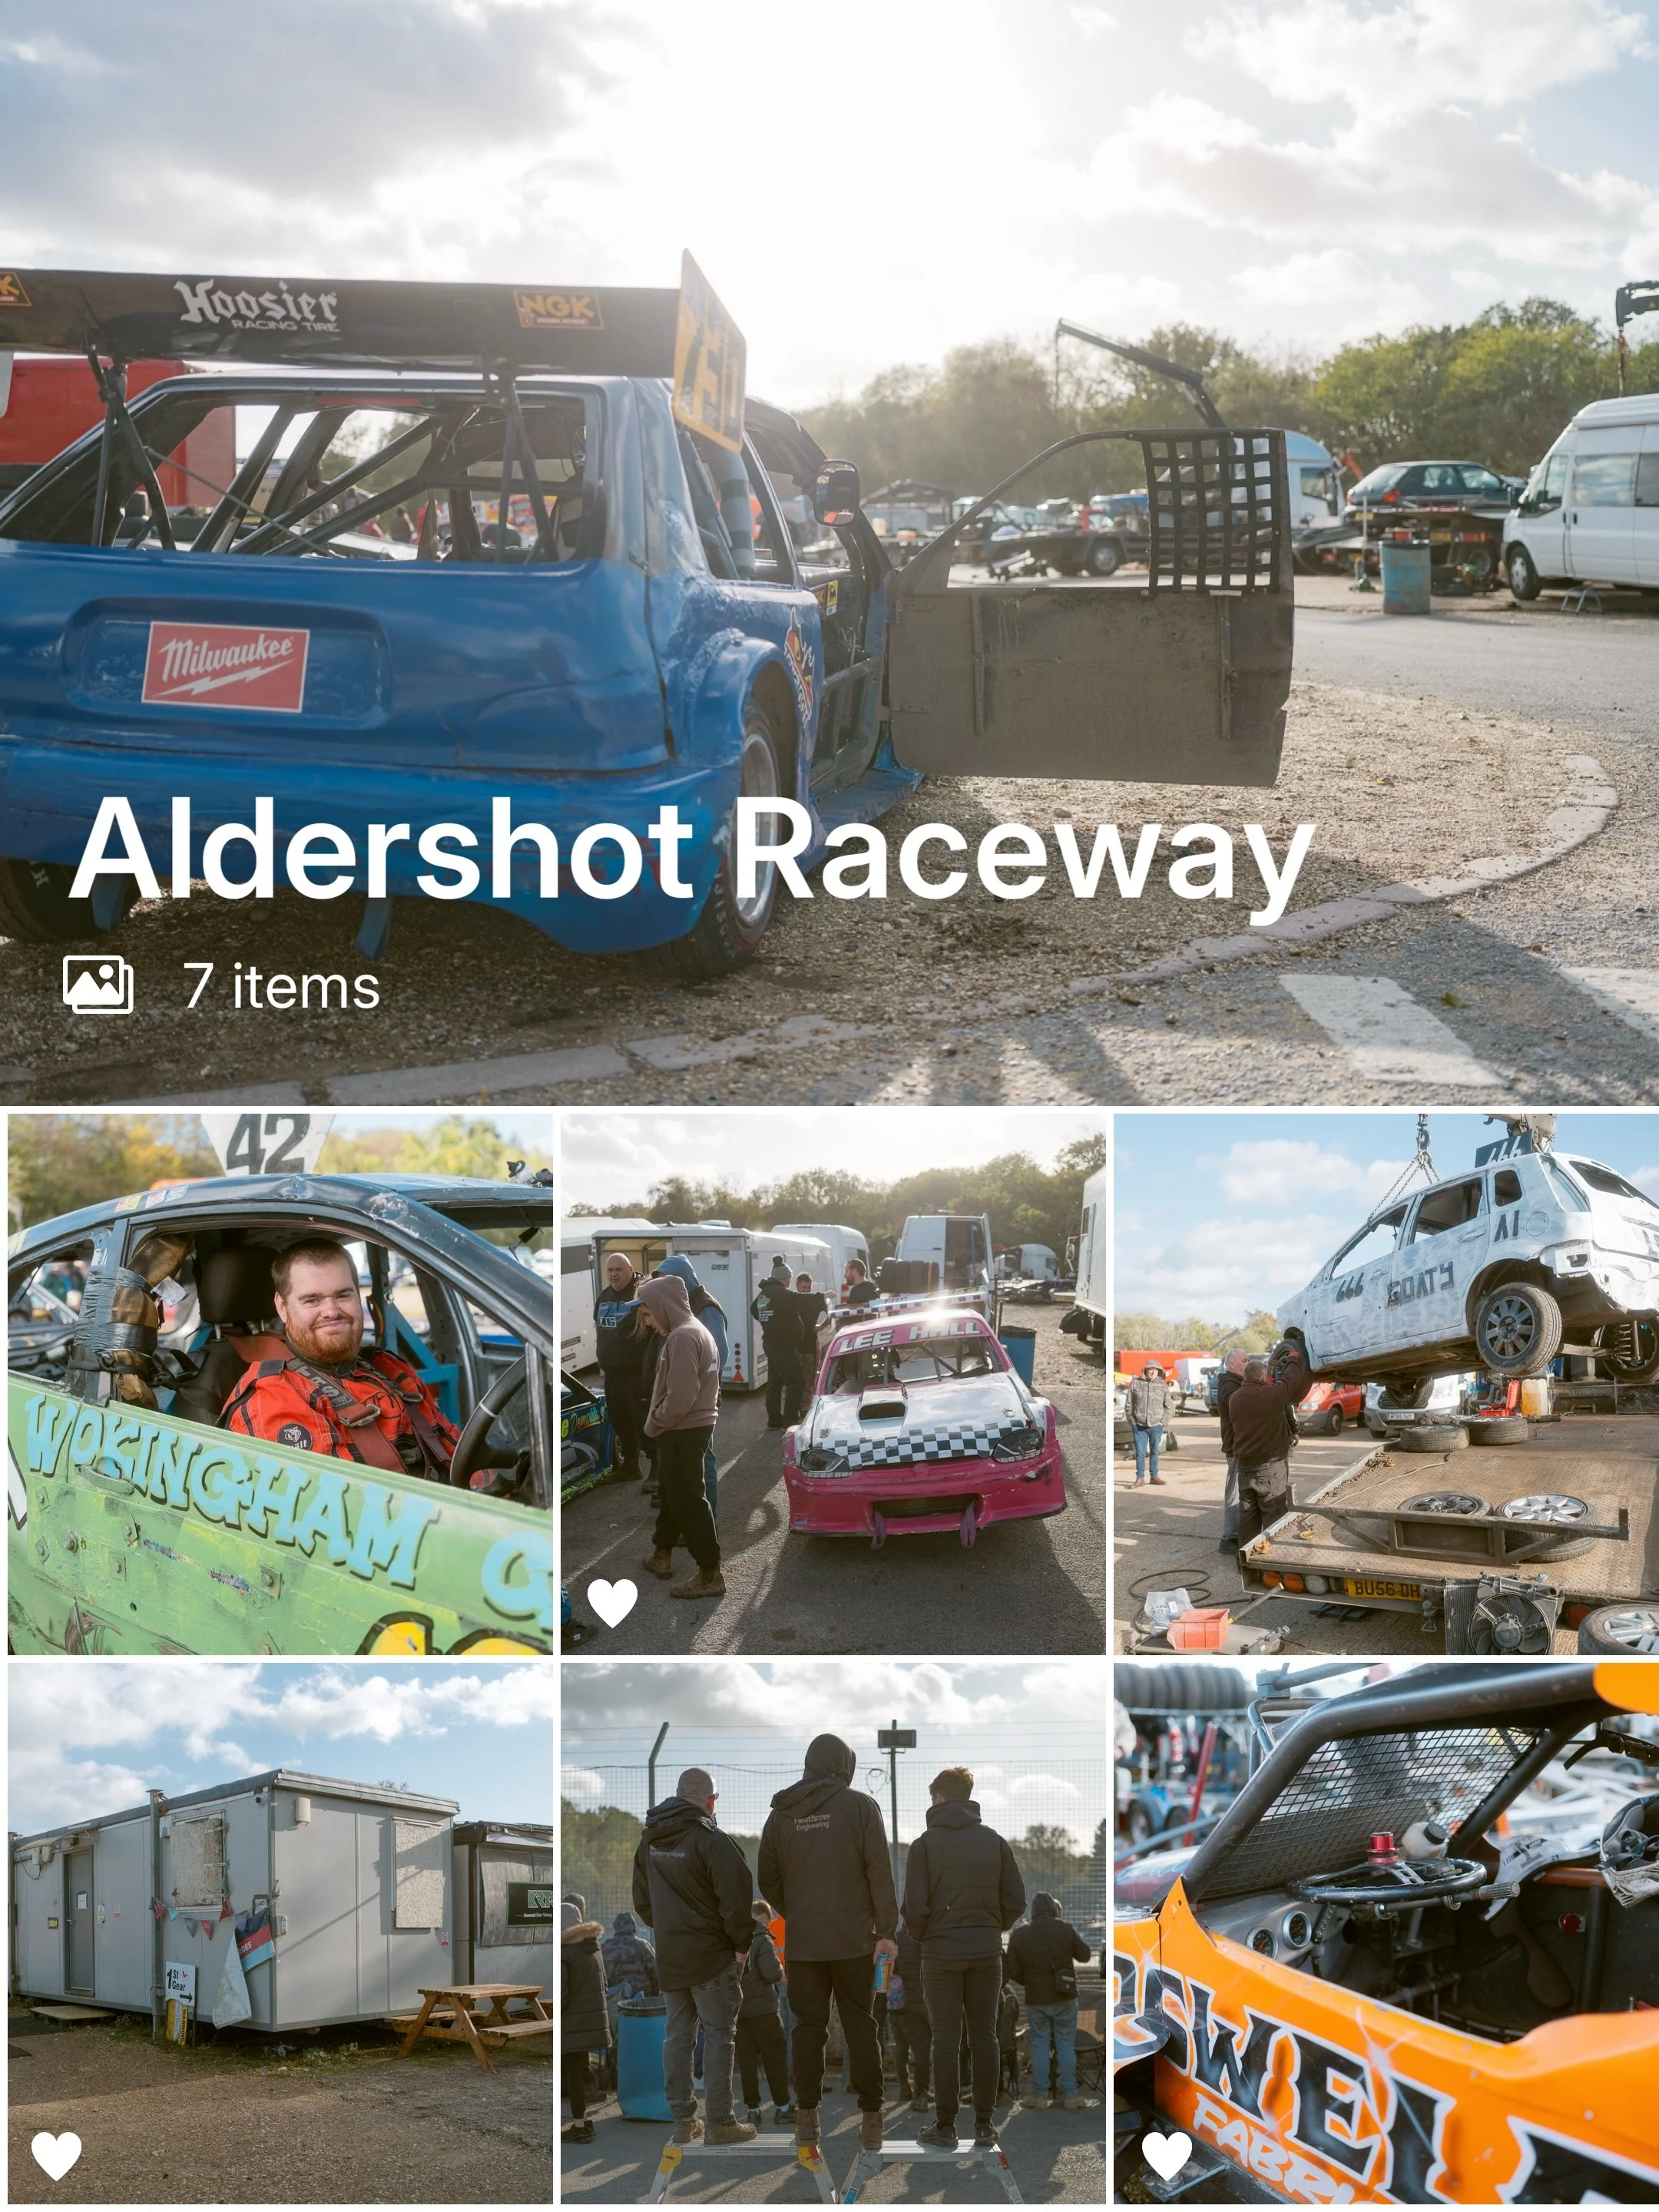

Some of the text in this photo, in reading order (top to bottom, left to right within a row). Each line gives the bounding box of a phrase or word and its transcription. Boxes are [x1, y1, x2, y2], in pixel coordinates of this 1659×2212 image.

[173, 278, 338, 323] Hoosier
[520, 294, 595, 319] NGK
[231, 320, 340, 333] RACING TIRE
[157, 633, 294, 683] Milwaukee
[226, 1114, 310, 1175] 42
[1386, 1260, 1455, 1307] GOATY
[839, 1322, 983, 1353] LEE HALL
[25, 1394, 441, 1590] WOKINGHAM
[1354, 1580, 1396, 1596] BU56
[796, 1821, 830, 1832] Engineering
[172, 1981, 186, 1992] Gear
